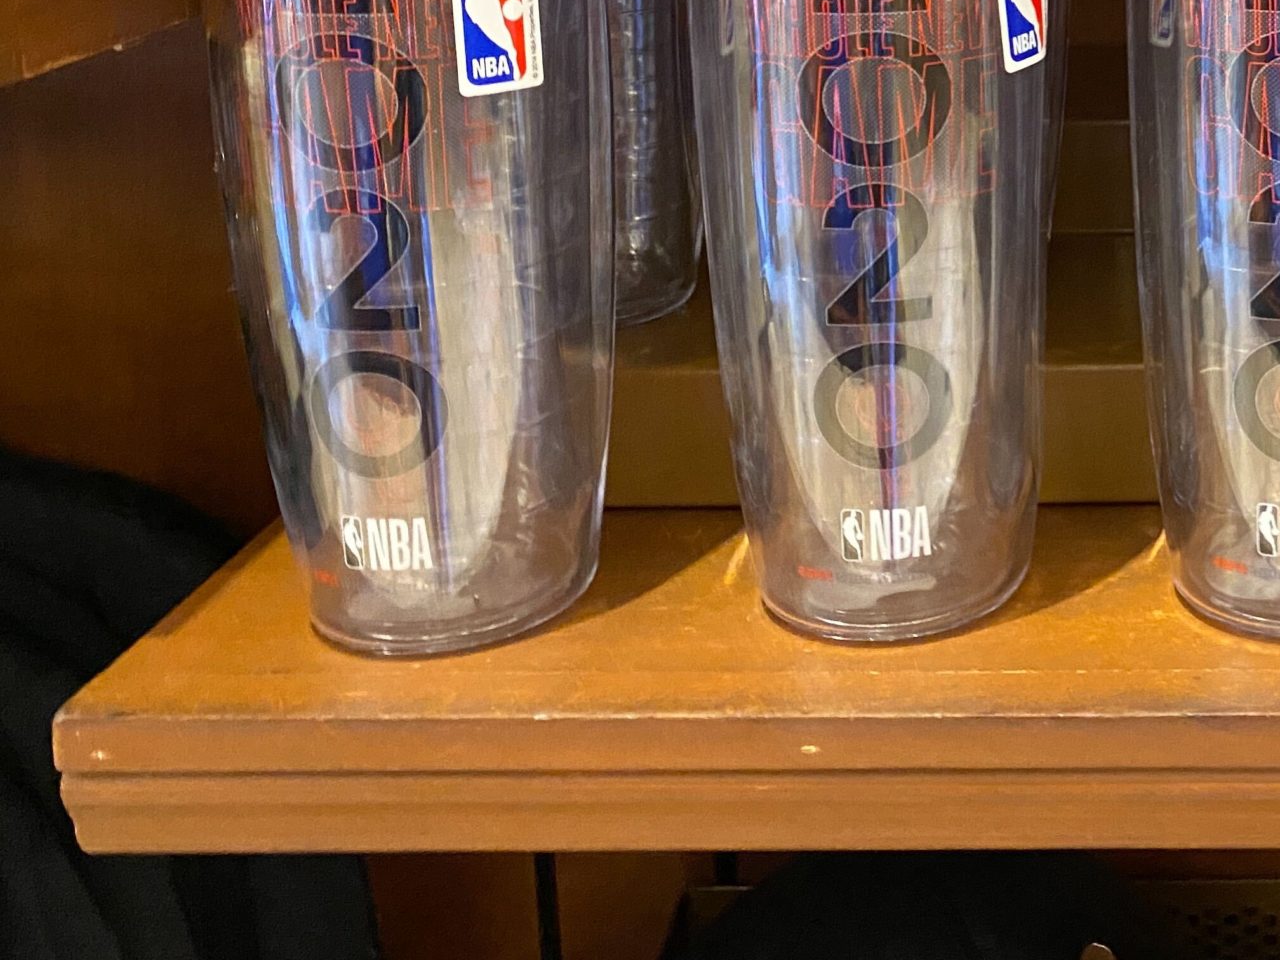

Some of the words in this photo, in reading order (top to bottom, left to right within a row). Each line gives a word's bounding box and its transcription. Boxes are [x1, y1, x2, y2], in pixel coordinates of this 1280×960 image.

[471, 54, 512, 80] NBA
[1012, 29, 1038, 56] NBA
[753, 53, 998, 209] GAME
[365, 516, 434, 571] NBA
[868, 505, 932, 561] NBA
